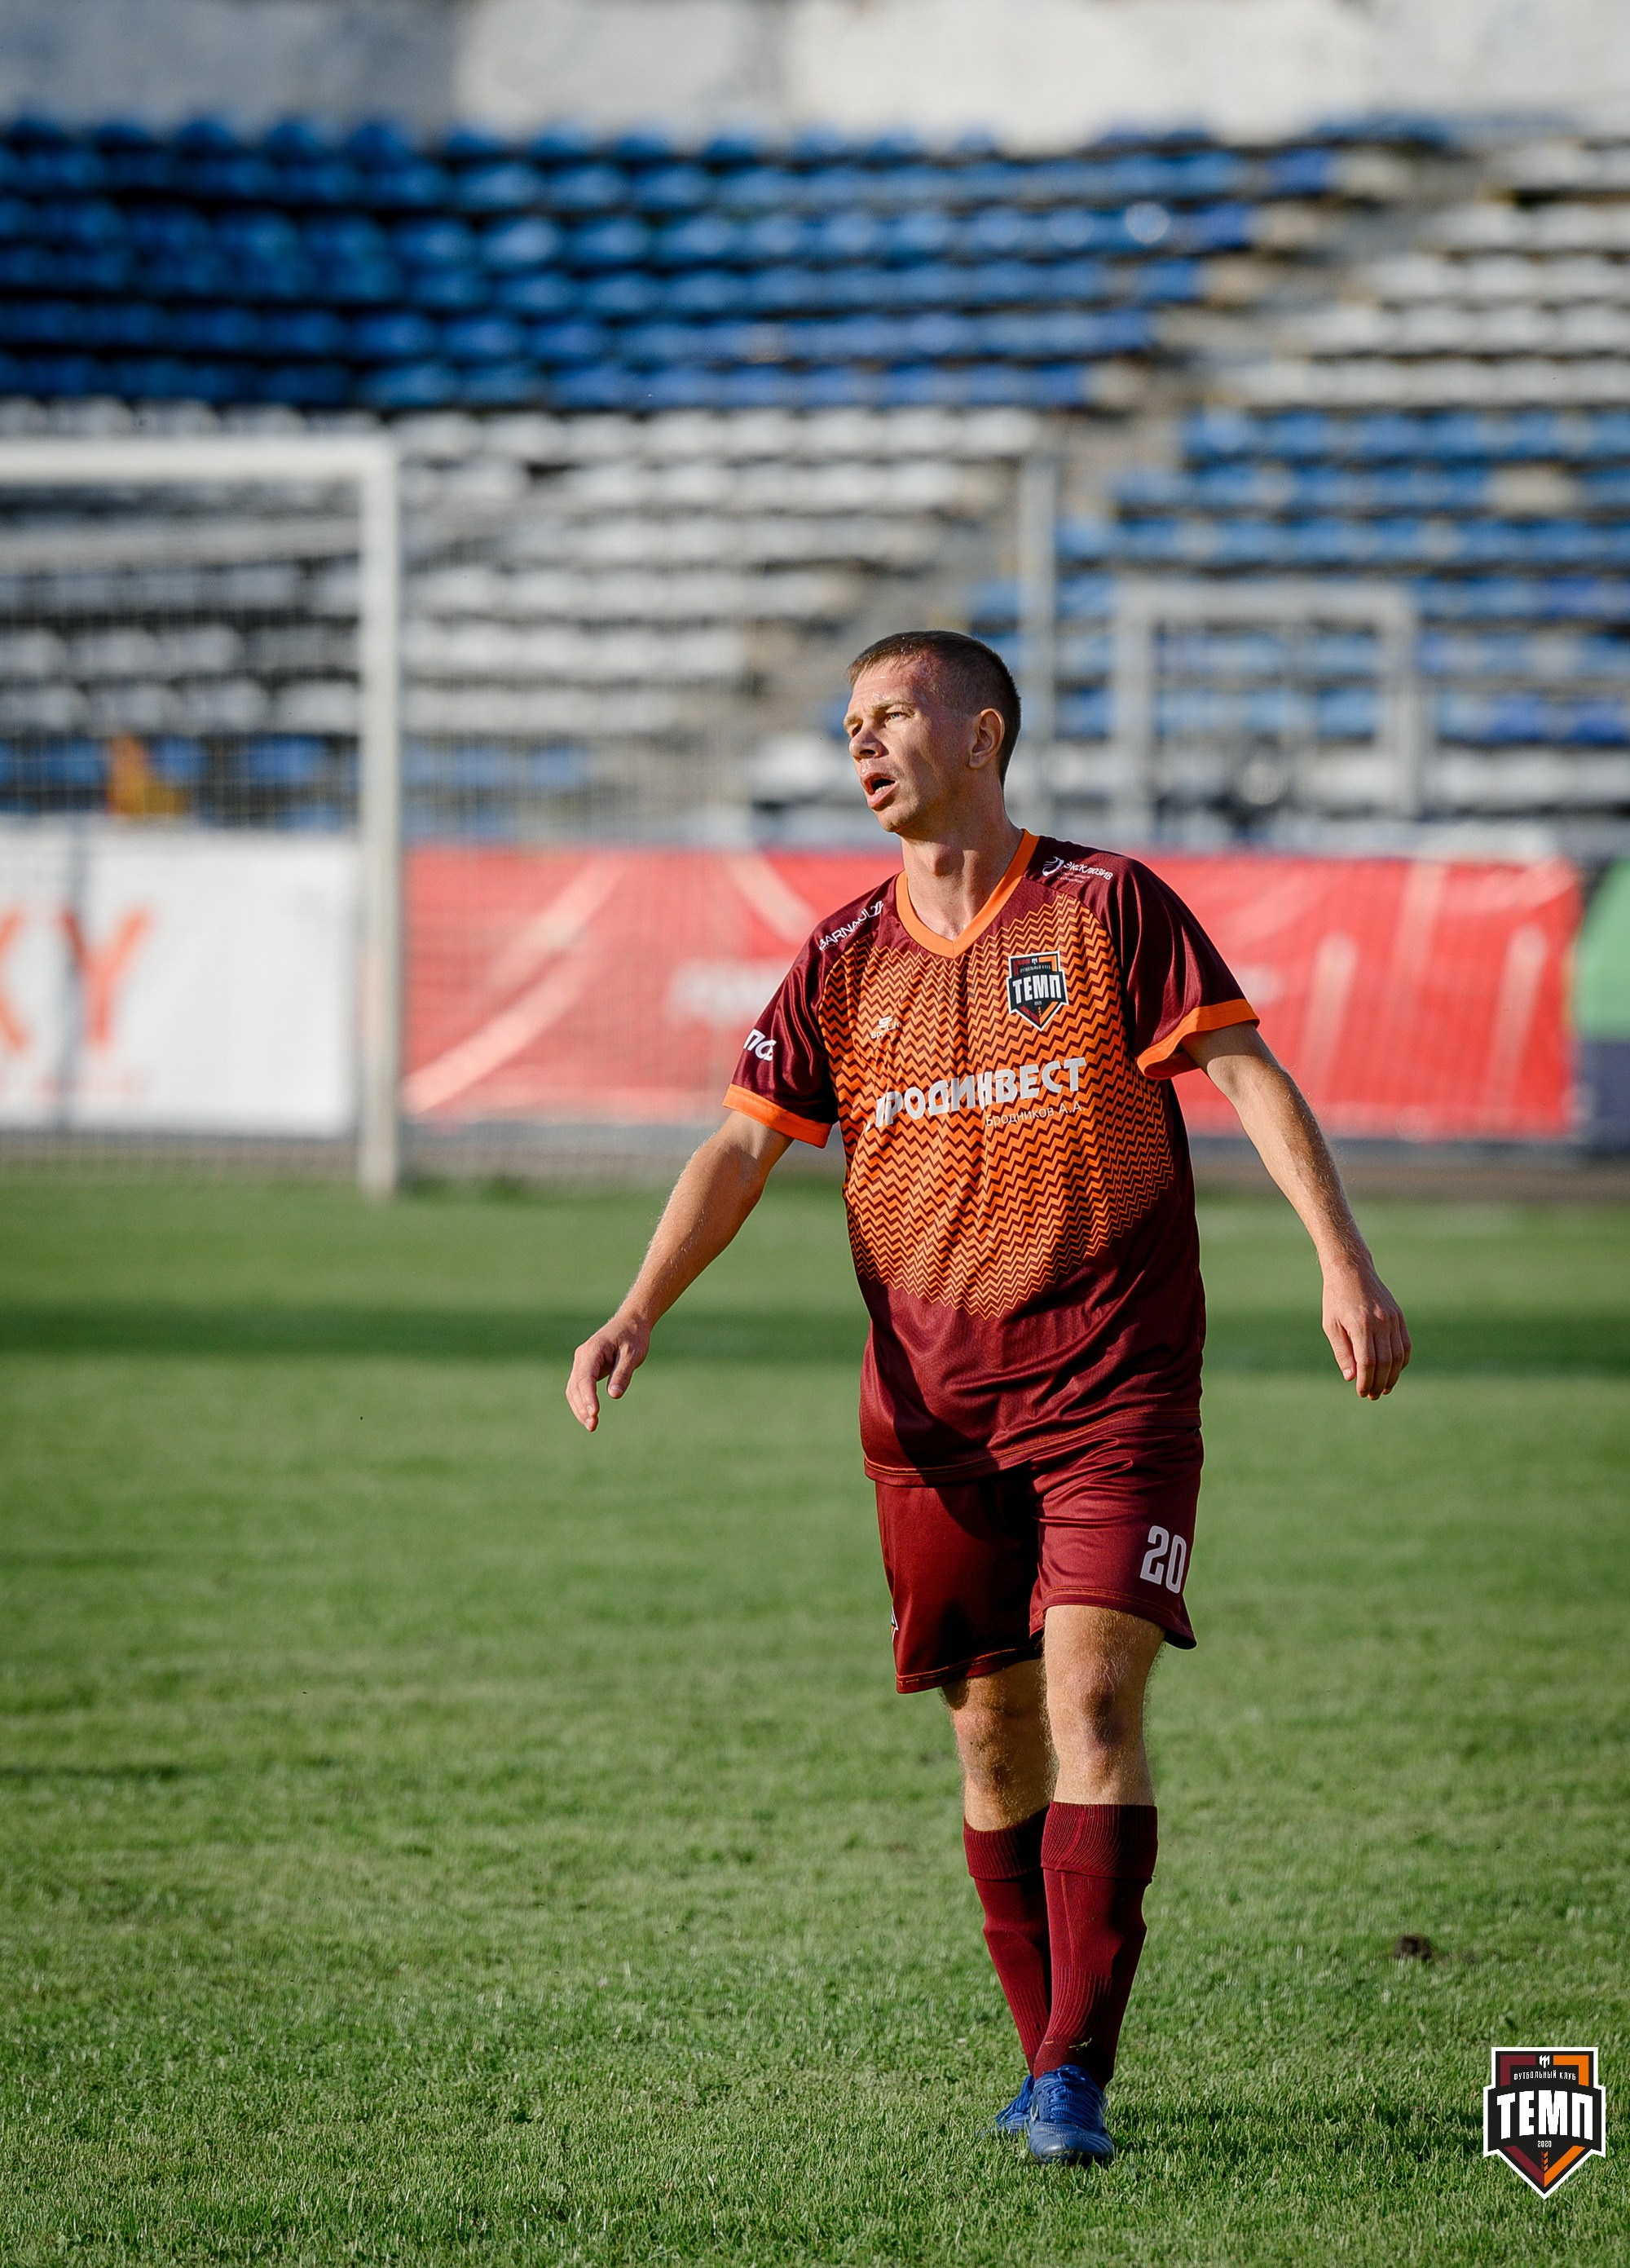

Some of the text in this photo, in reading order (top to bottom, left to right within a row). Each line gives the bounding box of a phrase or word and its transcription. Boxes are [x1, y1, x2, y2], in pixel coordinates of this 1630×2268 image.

[1012, 974, 1062, 1004] ТЕМП
[985, 1100, 1086, 1128] Бродников А.А.
[1140, 1525, 1187, 1594] 20
